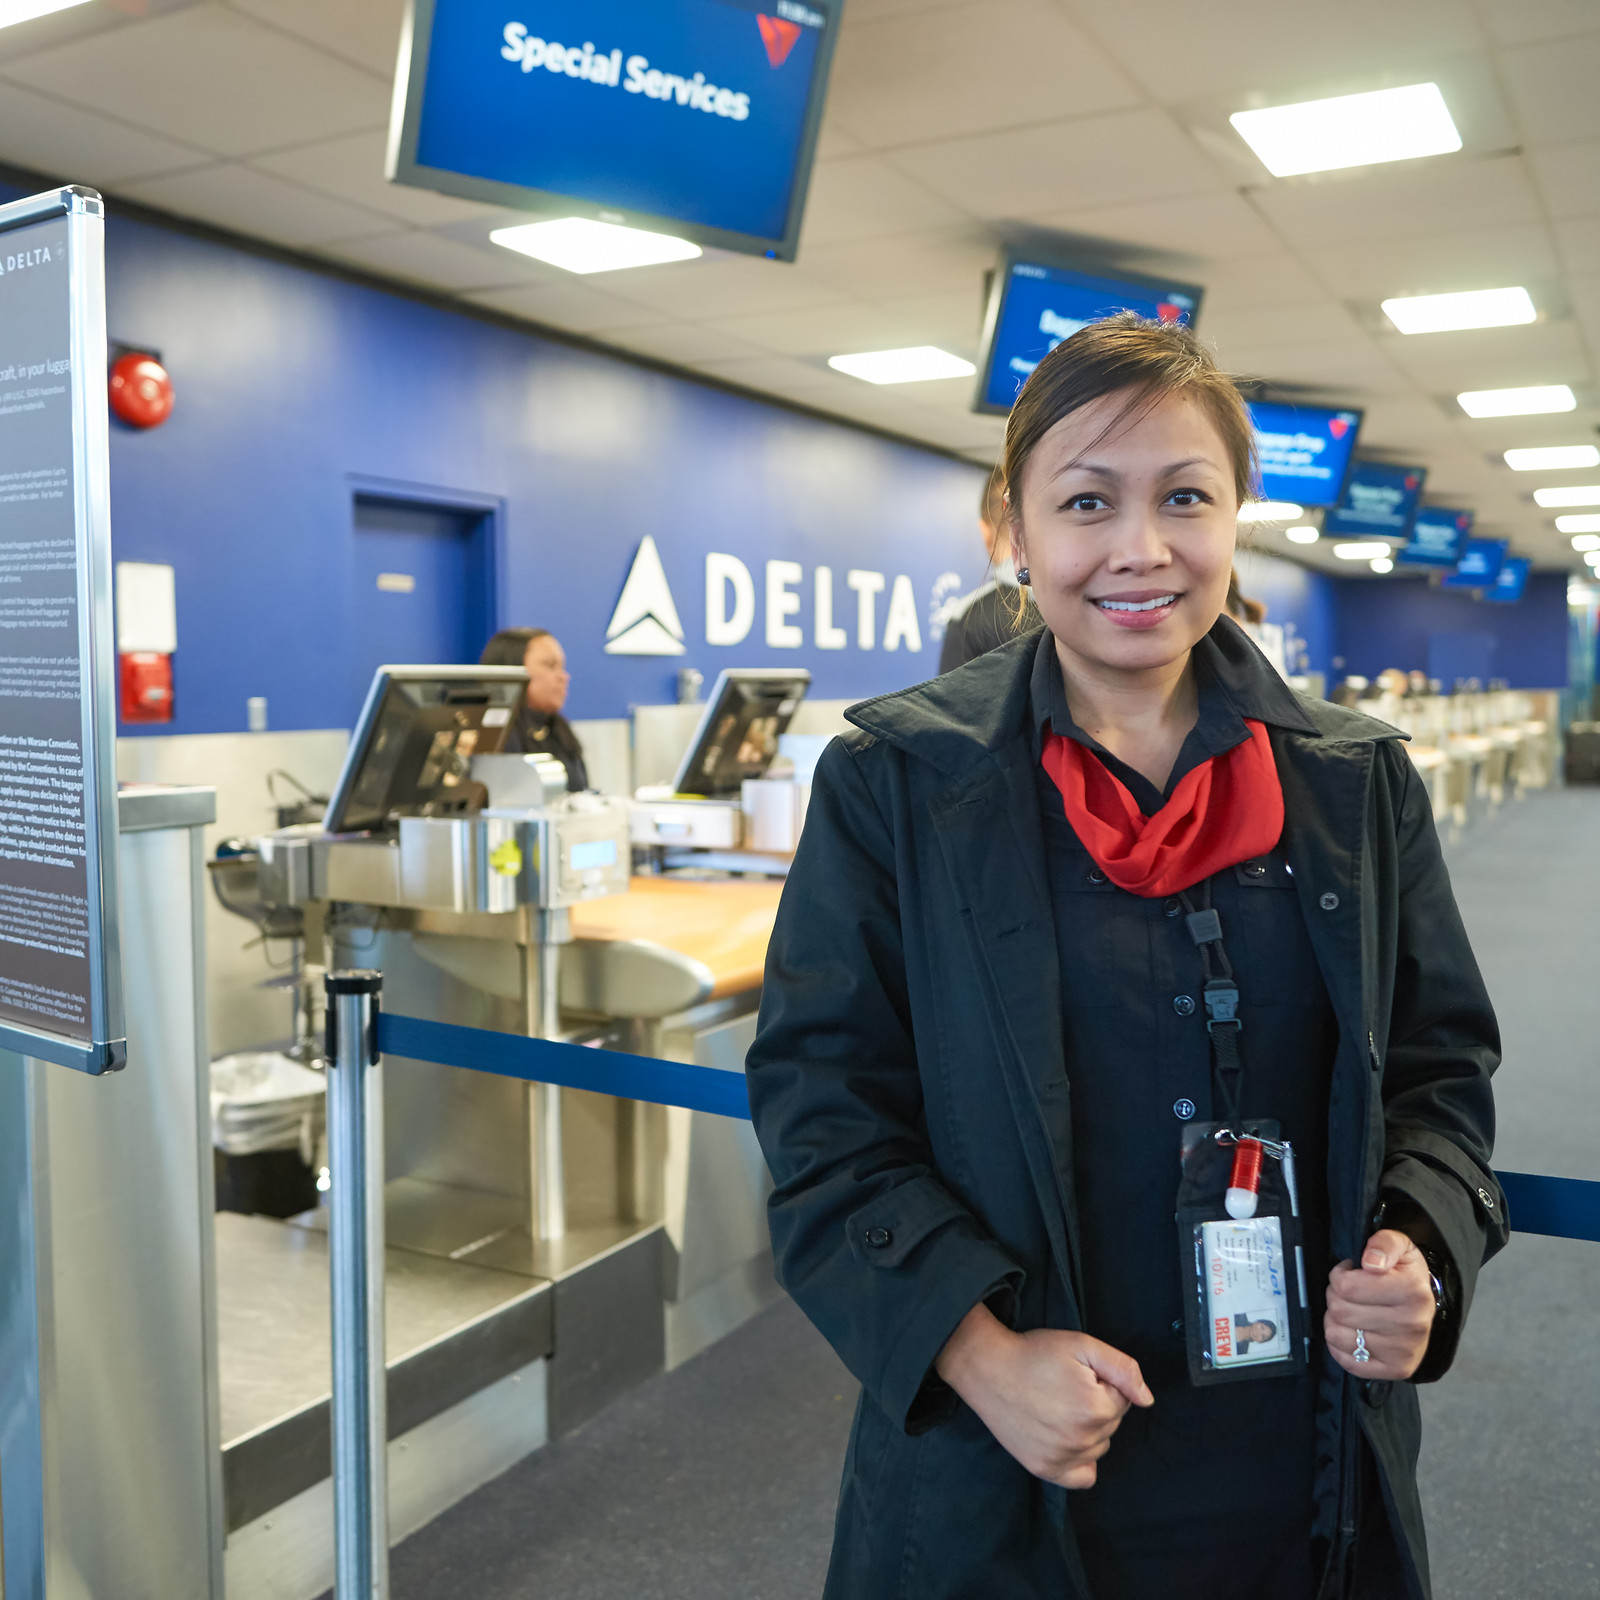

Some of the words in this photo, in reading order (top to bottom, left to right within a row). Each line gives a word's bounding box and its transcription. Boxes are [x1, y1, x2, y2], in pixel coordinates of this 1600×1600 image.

[501, 20, 623, 87] Special
[623, 55, 751, 121] Services
[7, 247, 52, 272] DELTA
[27, 364, 45, 378] your
[705, 551, 923, 652] DELTA
[61, 690, 74, 699] Delta
[49, 737, 79, 749] Convention.
[56, 753, 80, 763] economic
[61, 778, 83, 792] baggage
[66, 819, 75, 828] the
[55, 830, 64, 840] the
[64, 831, 76, 842] date
[45, 843, 64, 853] contact
[1211, 1256, 1225, 1297] 10/16
[1215, 1317, 1232, 1358] CREW
